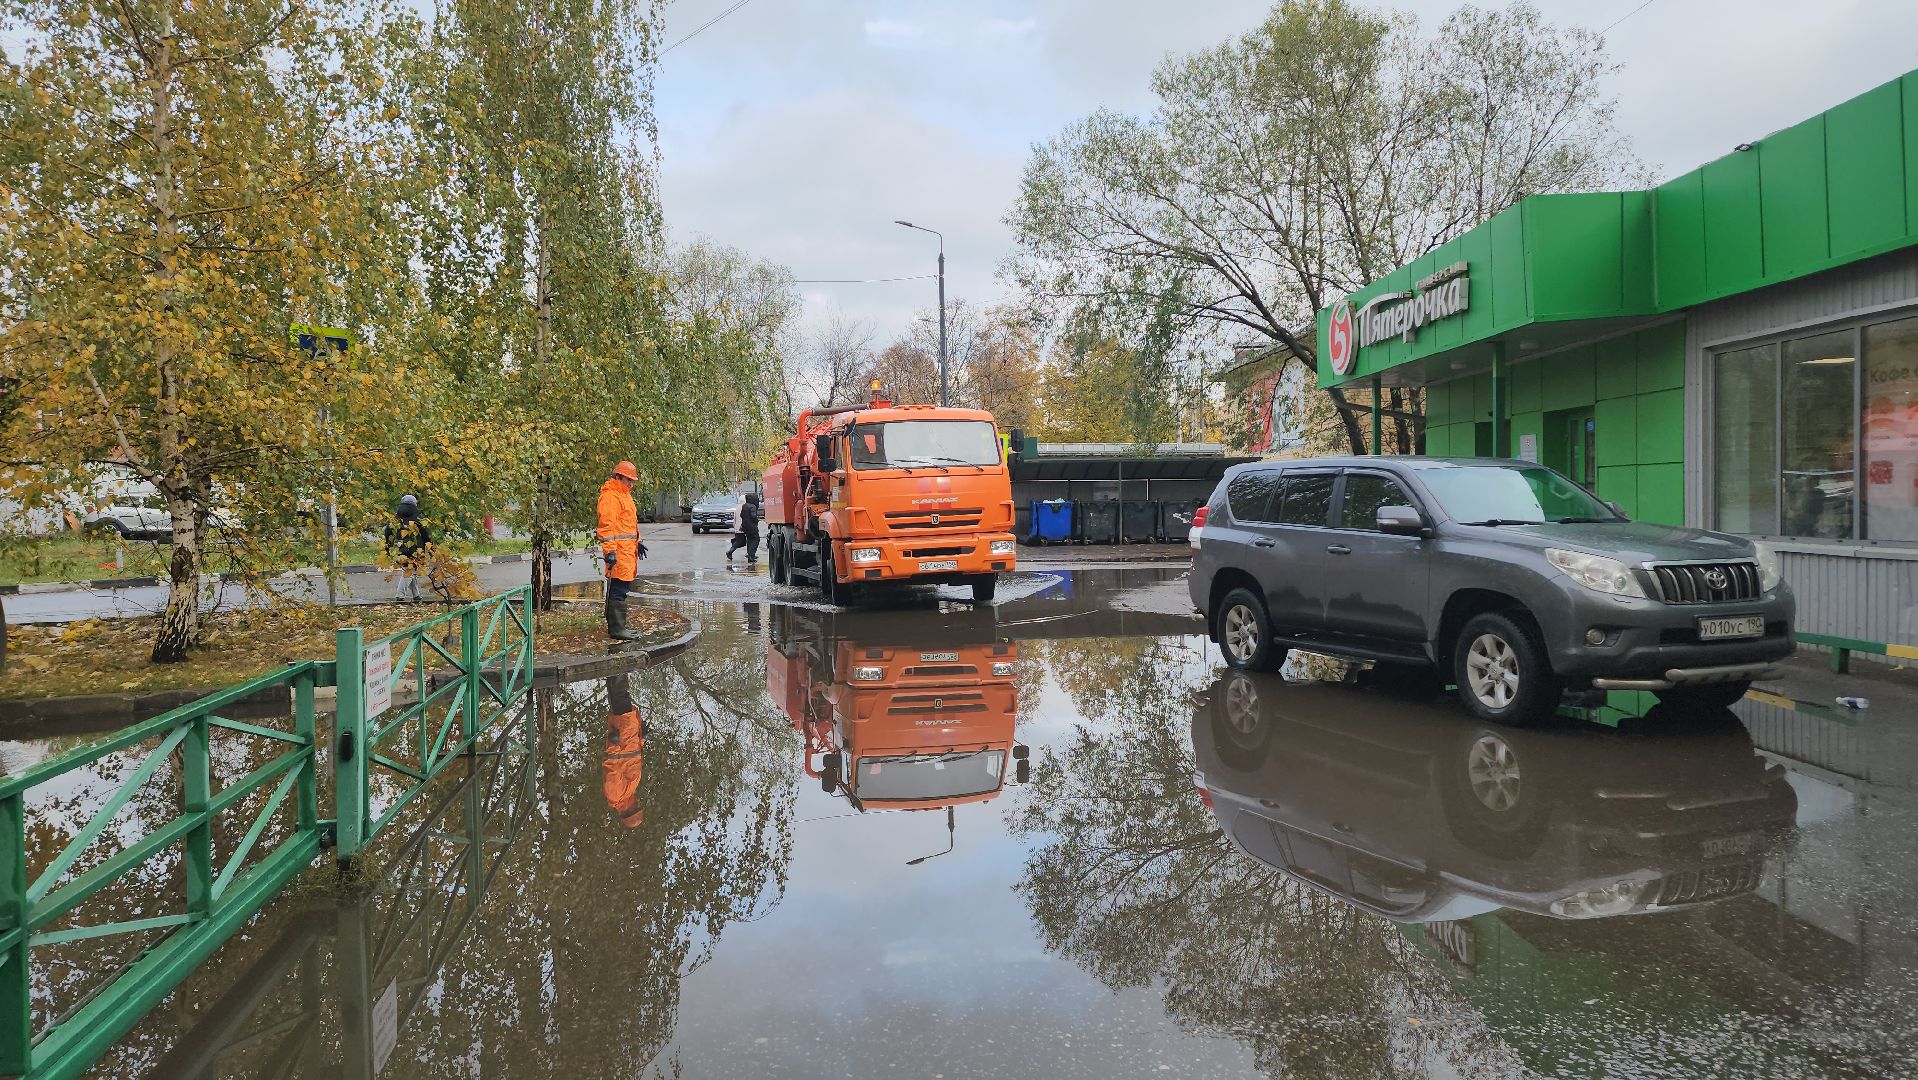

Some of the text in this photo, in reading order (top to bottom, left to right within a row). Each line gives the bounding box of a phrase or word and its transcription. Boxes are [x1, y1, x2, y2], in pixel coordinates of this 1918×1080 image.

[1356, 278, 1464, 348] Пятерочка
[1870, 366, 1910, 384] Кофе
[1745, 617, 1763, 630] 190
